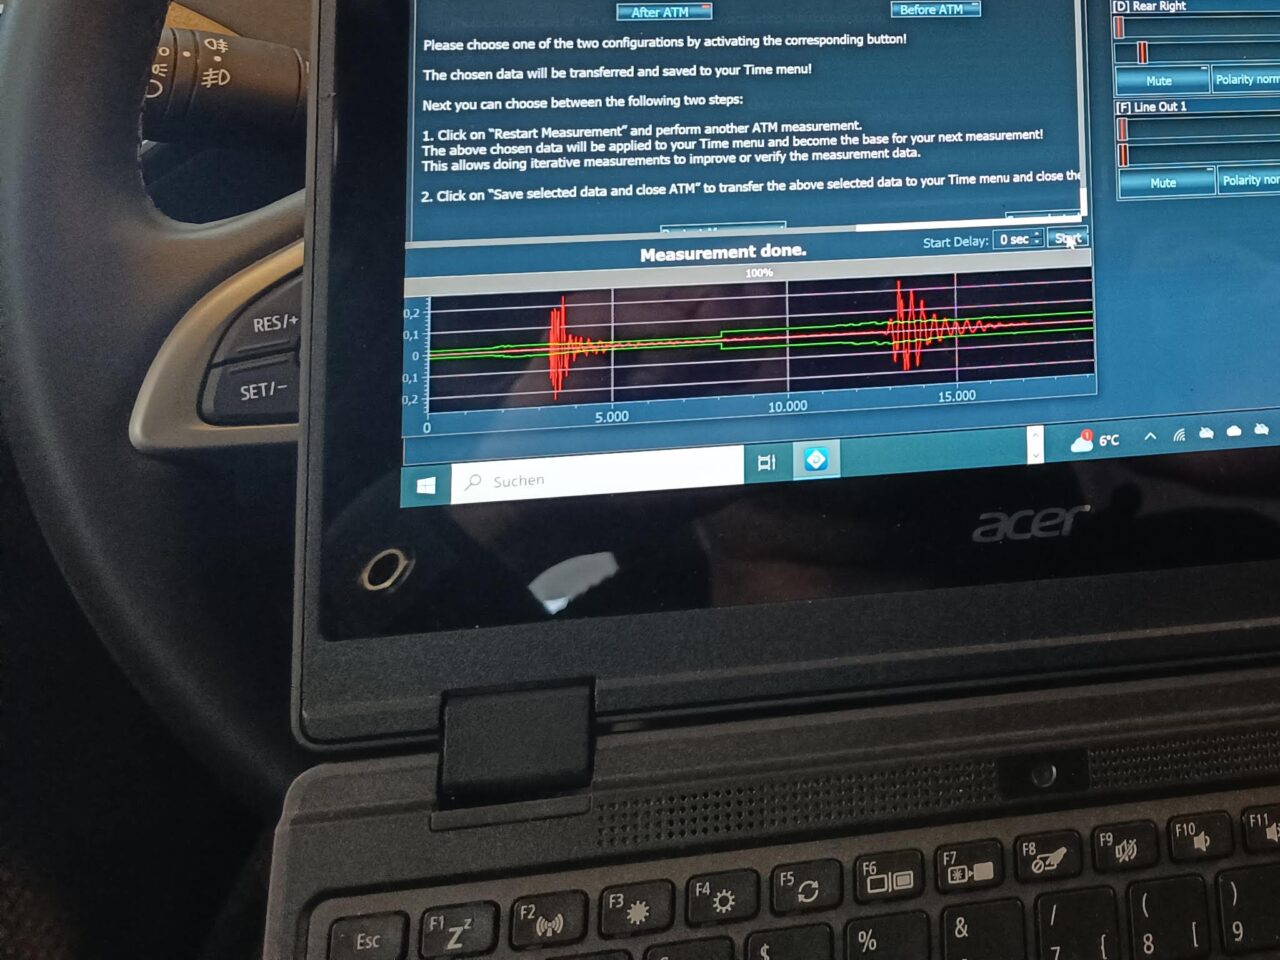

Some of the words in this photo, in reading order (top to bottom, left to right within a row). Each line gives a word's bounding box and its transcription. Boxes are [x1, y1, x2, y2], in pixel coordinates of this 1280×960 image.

[631, 6, 660, 18] After
[663, 7, 689, 18] ATM
[900, 4, 936, 15] Before
[939, 4, 964, 14] ATM
[1113, 1, 1130, 12] [D]
[1133, 1, 1157, 11] Rear
[1160, 1, 1187, 12] Right
[423, 39, 464, 51] Please
[467, 38, 510, 50] choose
[512, 41, 536, 50] one
[539, 38, 552, 49] of
[554, 38, 574, 49] the
[576, 38, 600, 49] two
[602, 36, 684, 50] configurations
[686, 36, 702, 49] by
[704, 35, 760, 48] activating
[763, 35, 783, 46] the
[785, 33, 864, 48] corresponding
[867, 33, 907, 45] button!
[1116, 102, 1131, 114] [F]
[1134, 102, 1156, 112] Line
[1159, 101, 1178, 111] Out
[1181, 101, 1187, 111] 1
[923, 237, 951, 248] Start
[954, 236, 989, 248] Delay:
[1000, 234, 1007, 245] 0
[1010, 235, 1029, 245] sec
[640, 246, 756, 262] Measurement
[761, 244, 807, 258] done.
[746, 268, 773, 278] 100%
[253, 314, 300, 333] RES/+
[412, 351, 419, 361] 0
[938, 389, 976, 403] 15.000
[768, 400, 808, 414] 10.000
[595, 410, 630, 424] 5.000
[423, 422, 431, 434] 0
[1099, 433, 1119, 447] 6°C
[493, 472, 546, 489] Suchen
[972, 505, 1091, 542] acer
[1250, 813, 1269, 828] F11
[1175, 822, 1196, 837] F10
[1100, 833, 1113, 847] F9
[1022, 841, 1037, 856] F8
[943, 851, 958, 866] F7
[862, 861, 877, 876] F6
[780, 871, 795, 886] F5
[695, 881, 711, 897] F4
[609, 893, 624, 908] F3
[520, 904, 536, 920] F2
[430, 915, 444, 931] F1
[356, 933, 381, 951] Esc
